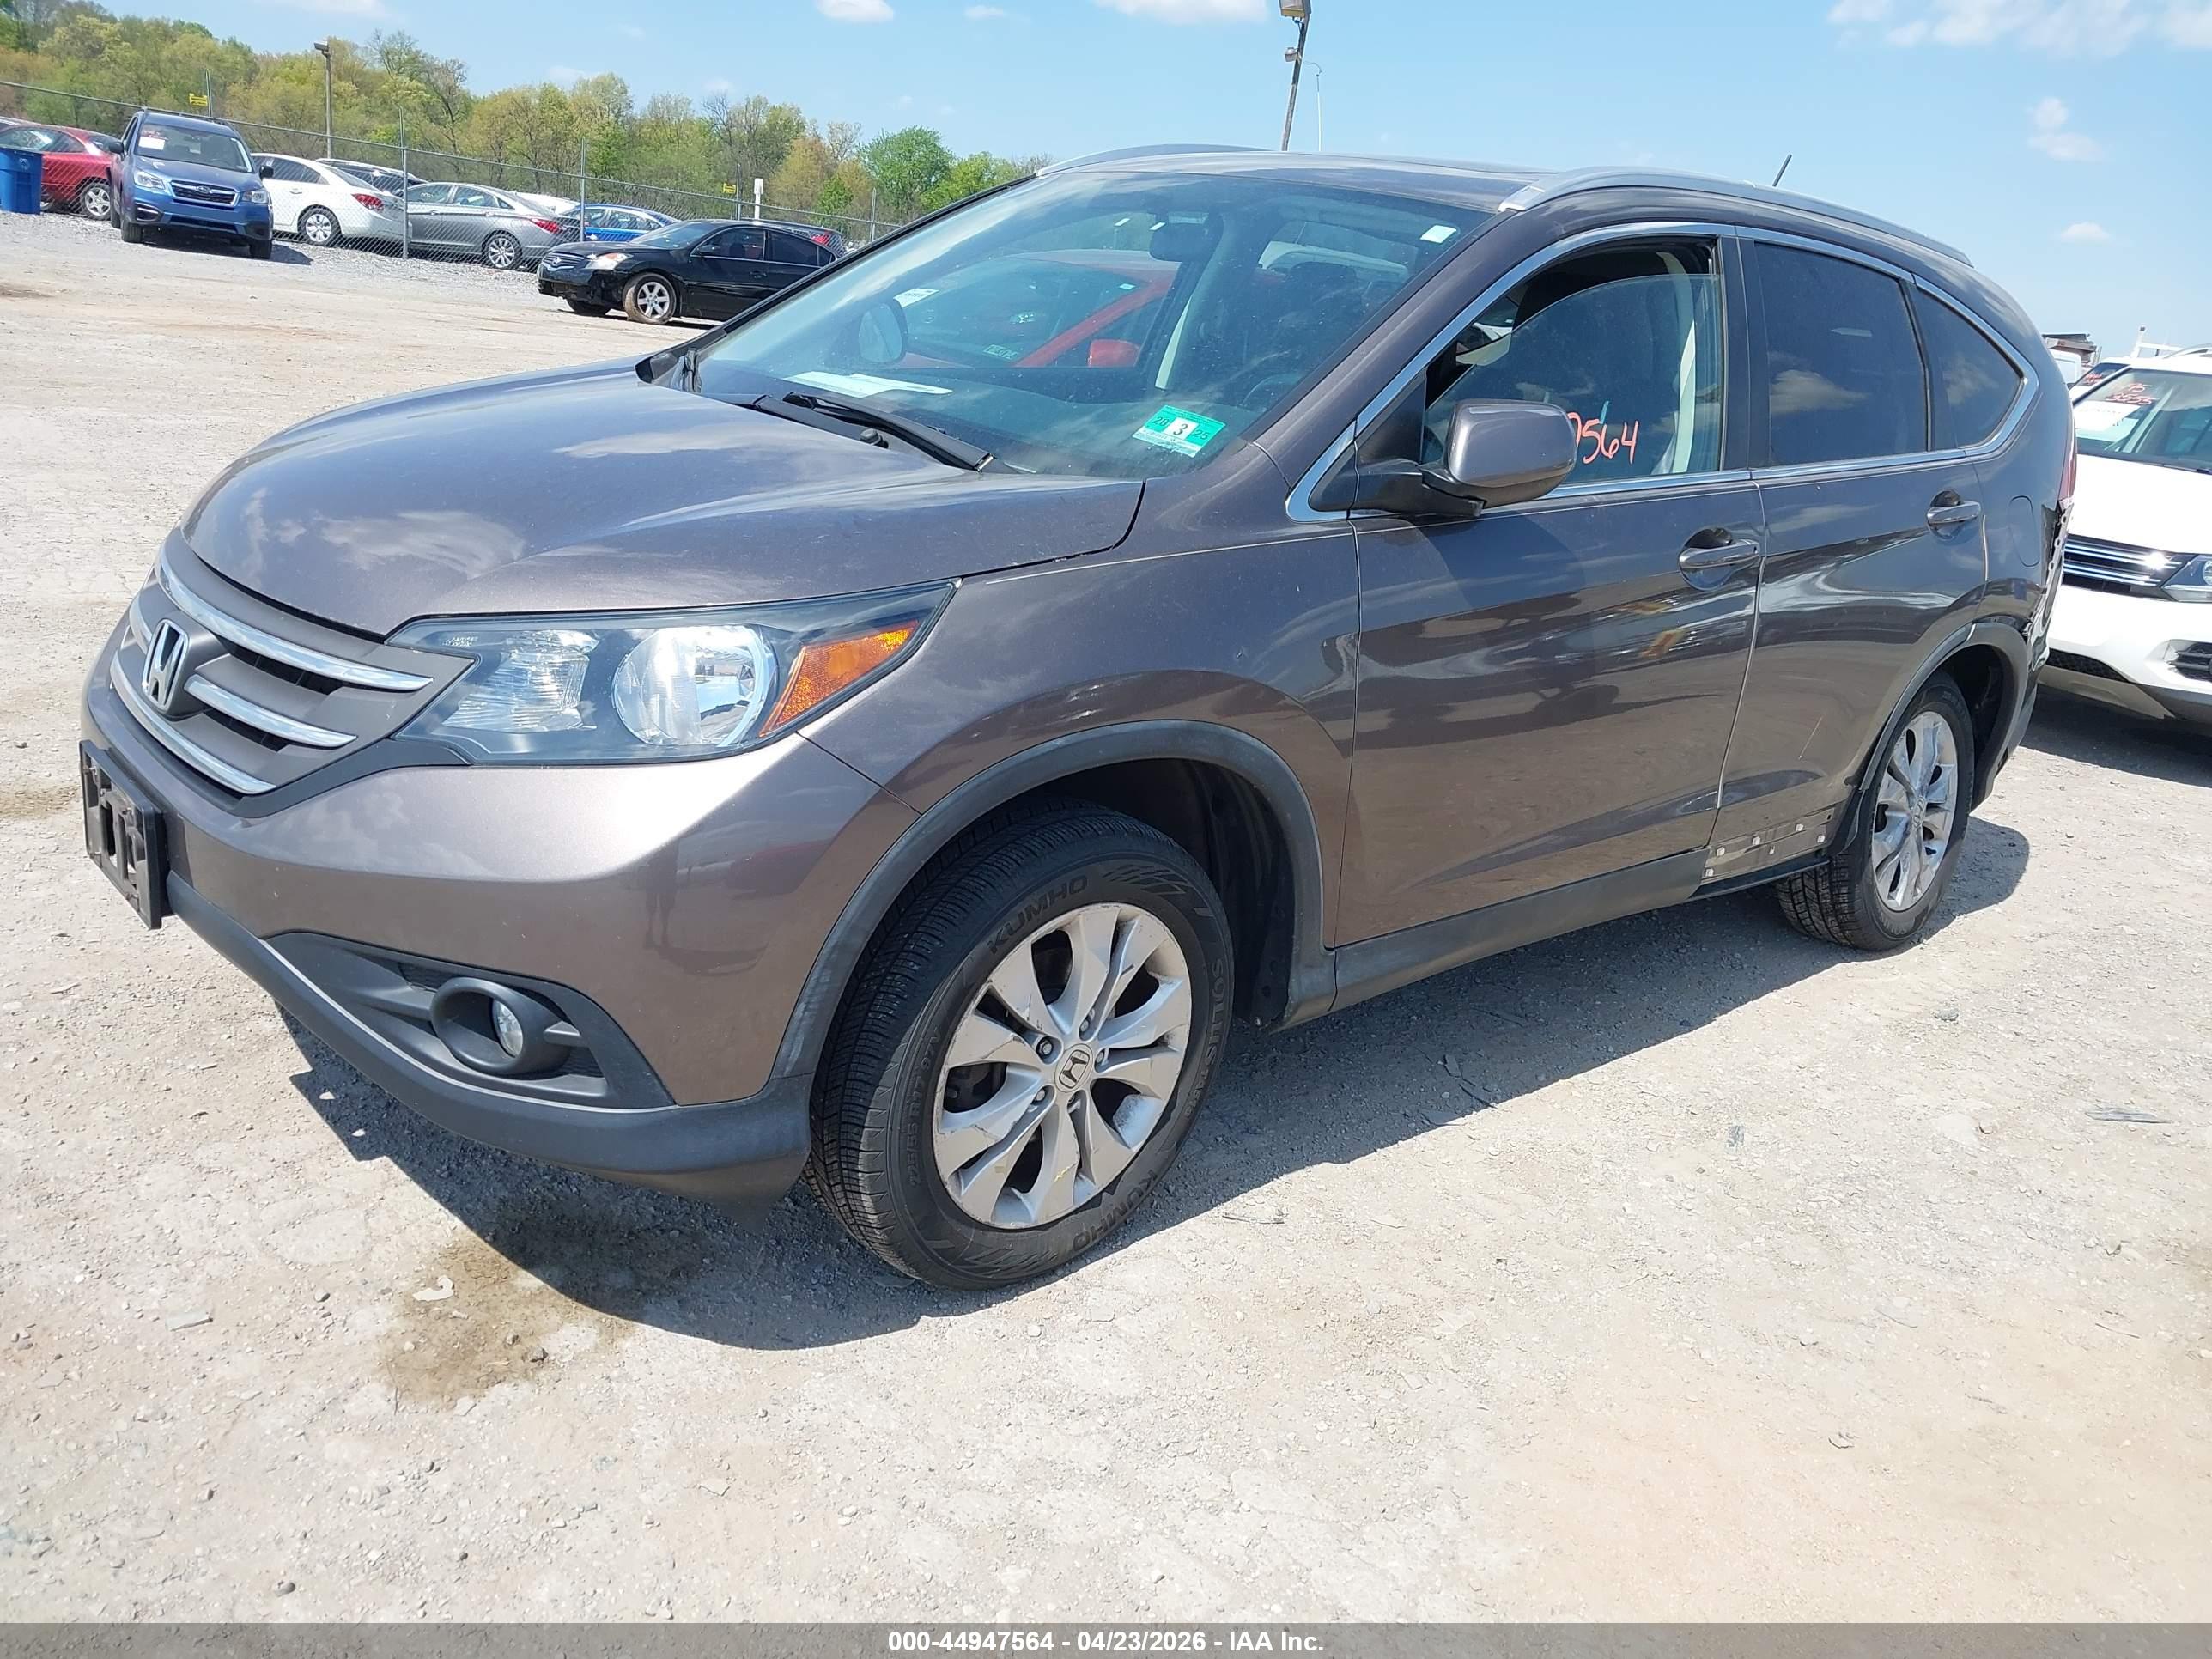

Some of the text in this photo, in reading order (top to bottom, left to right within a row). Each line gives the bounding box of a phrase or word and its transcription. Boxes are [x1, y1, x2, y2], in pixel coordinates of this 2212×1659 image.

[1152, 416, 1170, 428] 20
[1173, 423, 1188, 436] 3
[1192, 429, 1210, 441] 25
[987, 875, 1088, 955] KUMHO
[1206, 958, 1226, 1066] SOLUS
[1073, 1170, 1158, 1250] KUMHO
